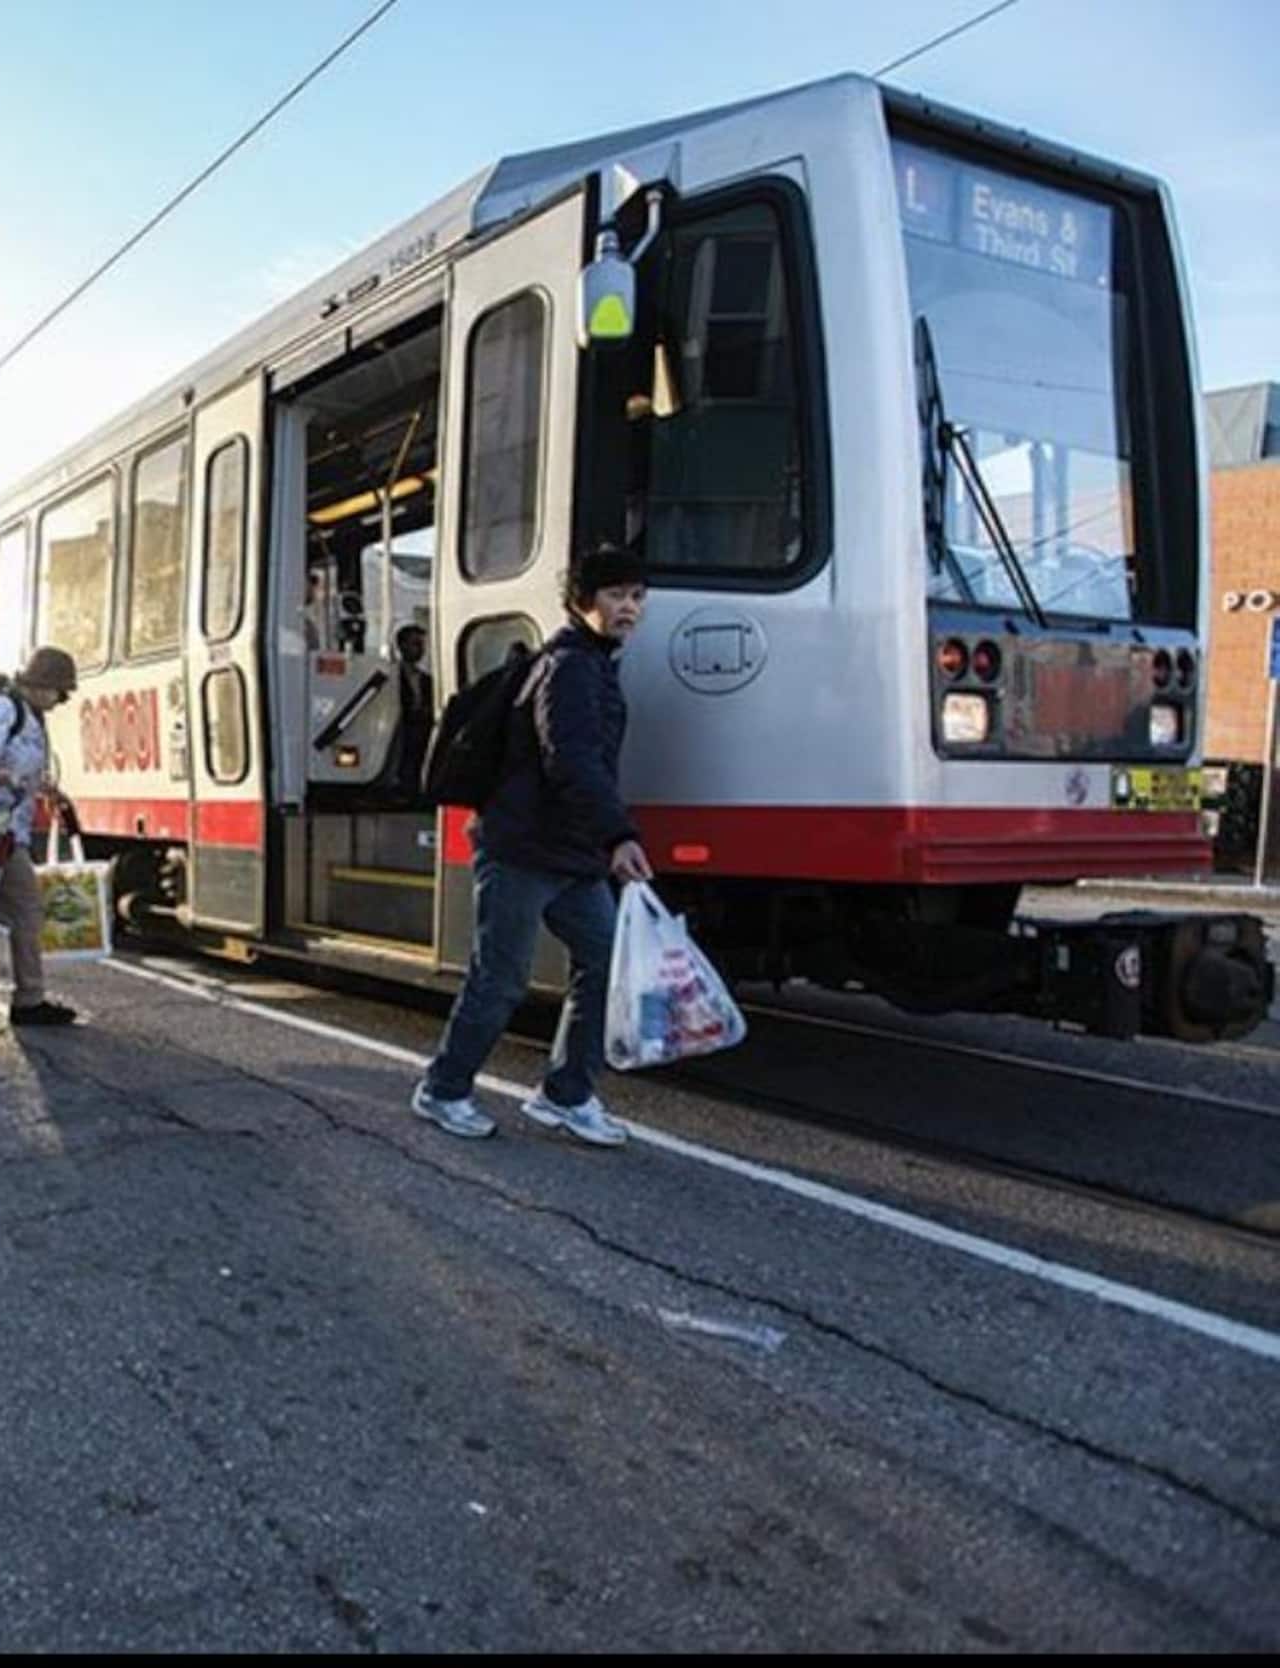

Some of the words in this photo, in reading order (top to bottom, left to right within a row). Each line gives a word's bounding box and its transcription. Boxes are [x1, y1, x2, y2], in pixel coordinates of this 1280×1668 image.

[973, 183, 1049, 238] Evans
[1060, 209, 1078, 244] &
[975, 223, 1041, 267] Third
[1049, 244, 1078, 277] St
